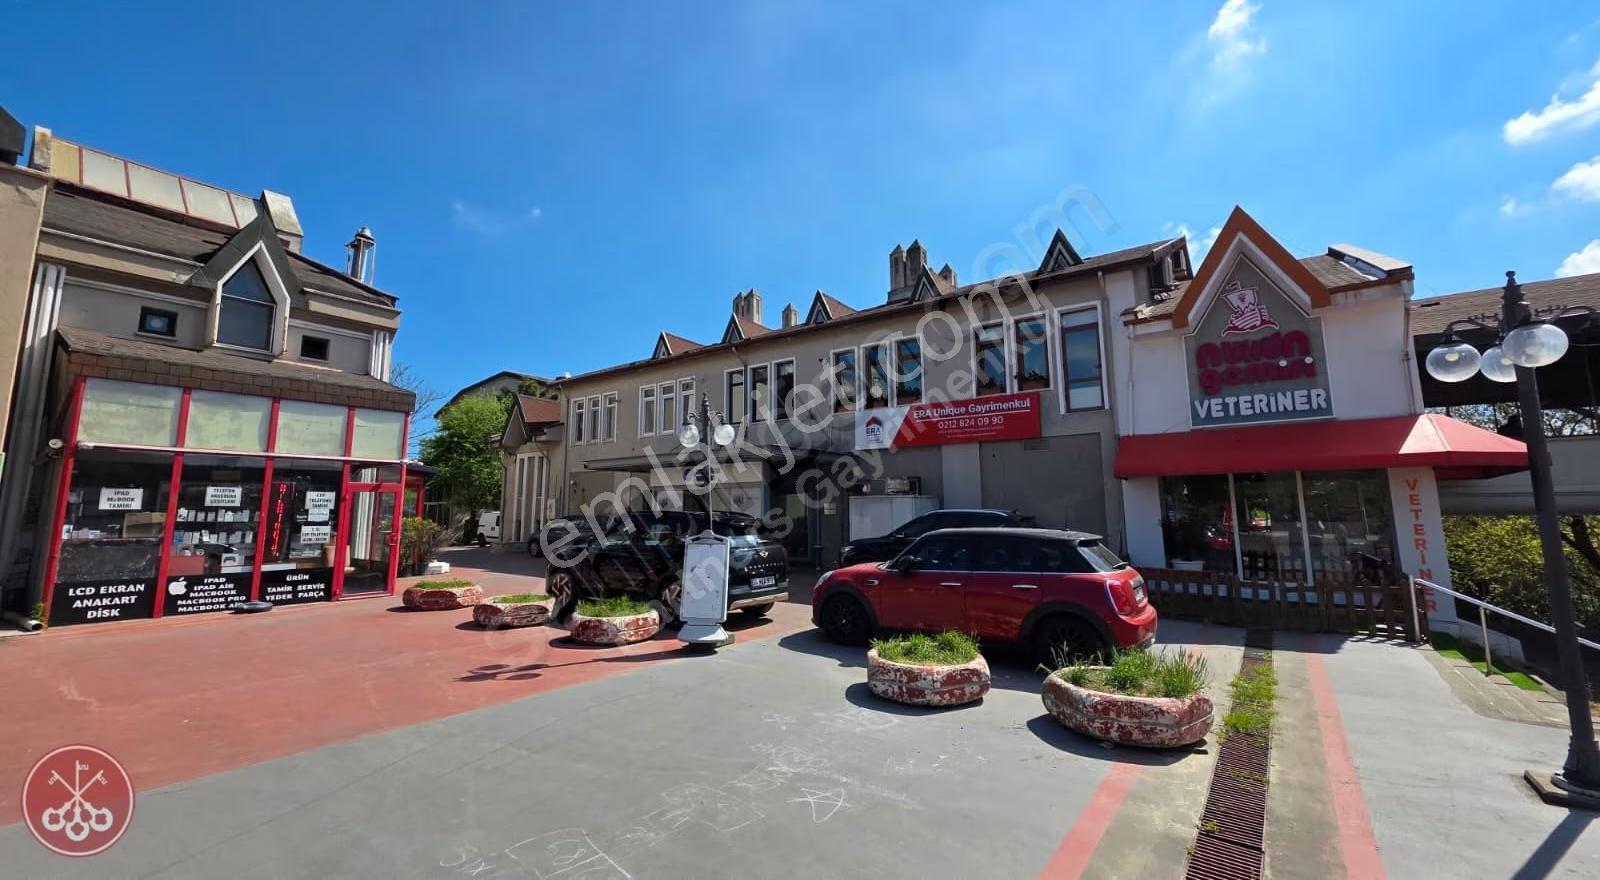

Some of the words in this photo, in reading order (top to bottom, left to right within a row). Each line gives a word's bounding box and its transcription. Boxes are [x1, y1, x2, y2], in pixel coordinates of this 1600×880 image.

[913, 409, 933, 419] ERA
[933, 405, 966, 417] Unique
[968, 397, 1031, 413] Gayrimenkul
[938, 420, 957, 429] 0212
[959, 418, 975, 427] 824
[977, 416, 990, 426] 09
[991, 415, 1004, 425] 90
[286, 573, 310, 582] ÜRÜN
[68, 586, 96, 597] LCD
[99, 583, 145, 594] EKRAN
[189, 589, 237, 598] MACBOOK
[265, 593, 293, 601] YEDEK
[297, 590, 325, 599] PARÇA
[72, 595, 138, 608] ANAKART
[176, 597, 226, 606] MACBOOK
[177, 603, 226, 612] MACBOOK
